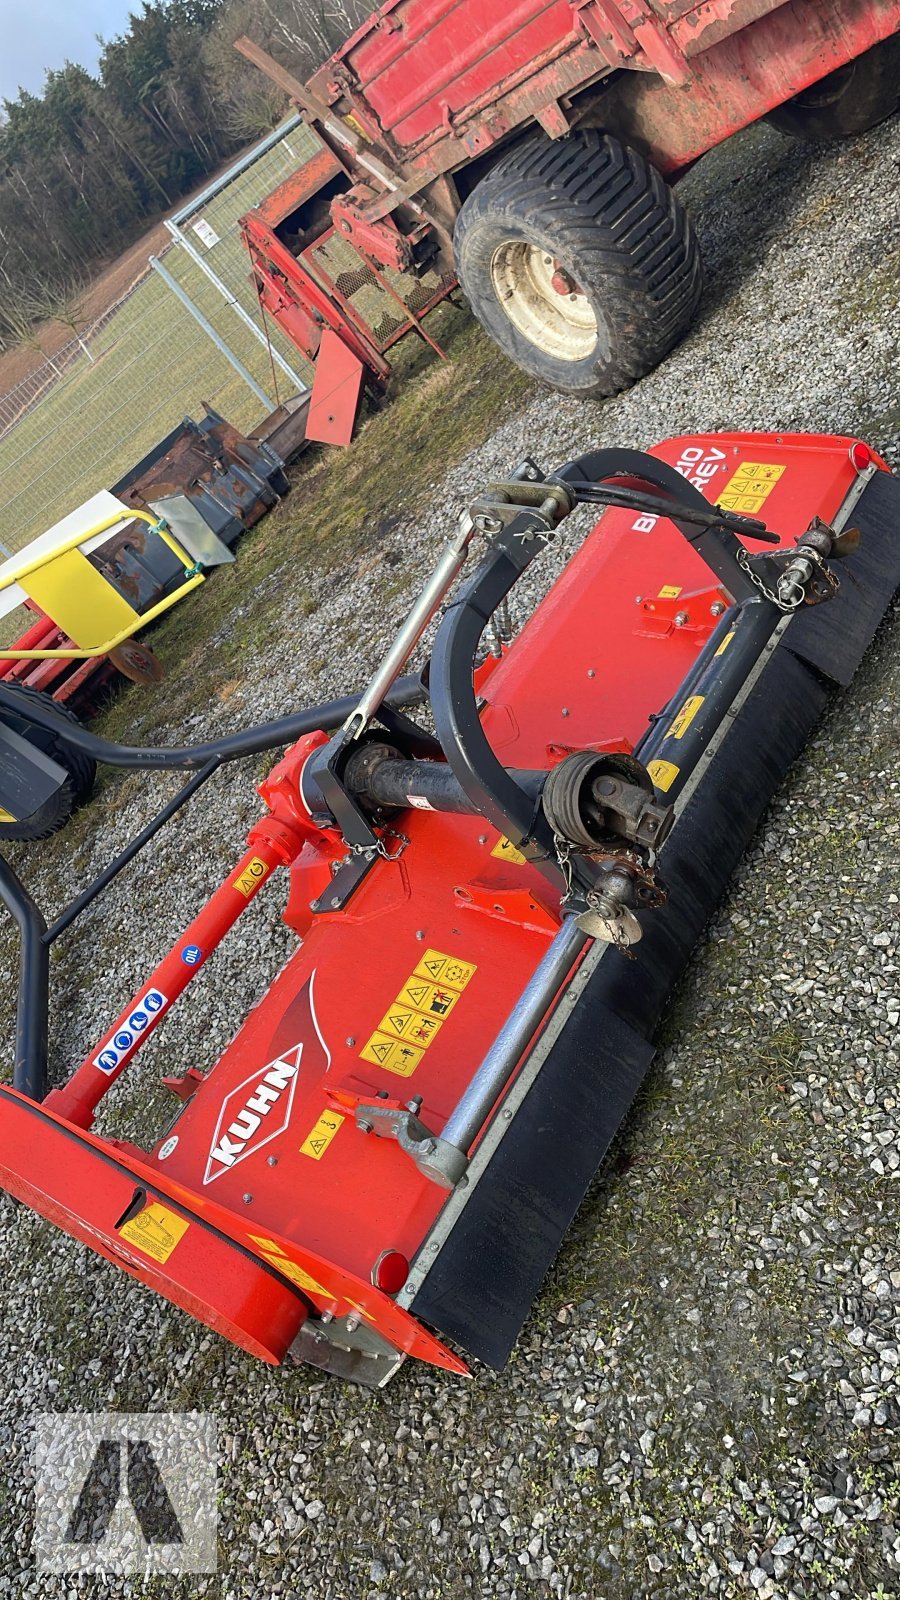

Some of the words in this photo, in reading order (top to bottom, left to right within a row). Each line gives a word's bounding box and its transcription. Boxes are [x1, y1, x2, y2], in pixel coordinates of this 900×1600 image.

[689, 447, 726, 493] REV
[185, 949, 198, 964] OIL
[459, 969, 470, 985] STOP
[210, 1059, 298, 1168] KUHN
